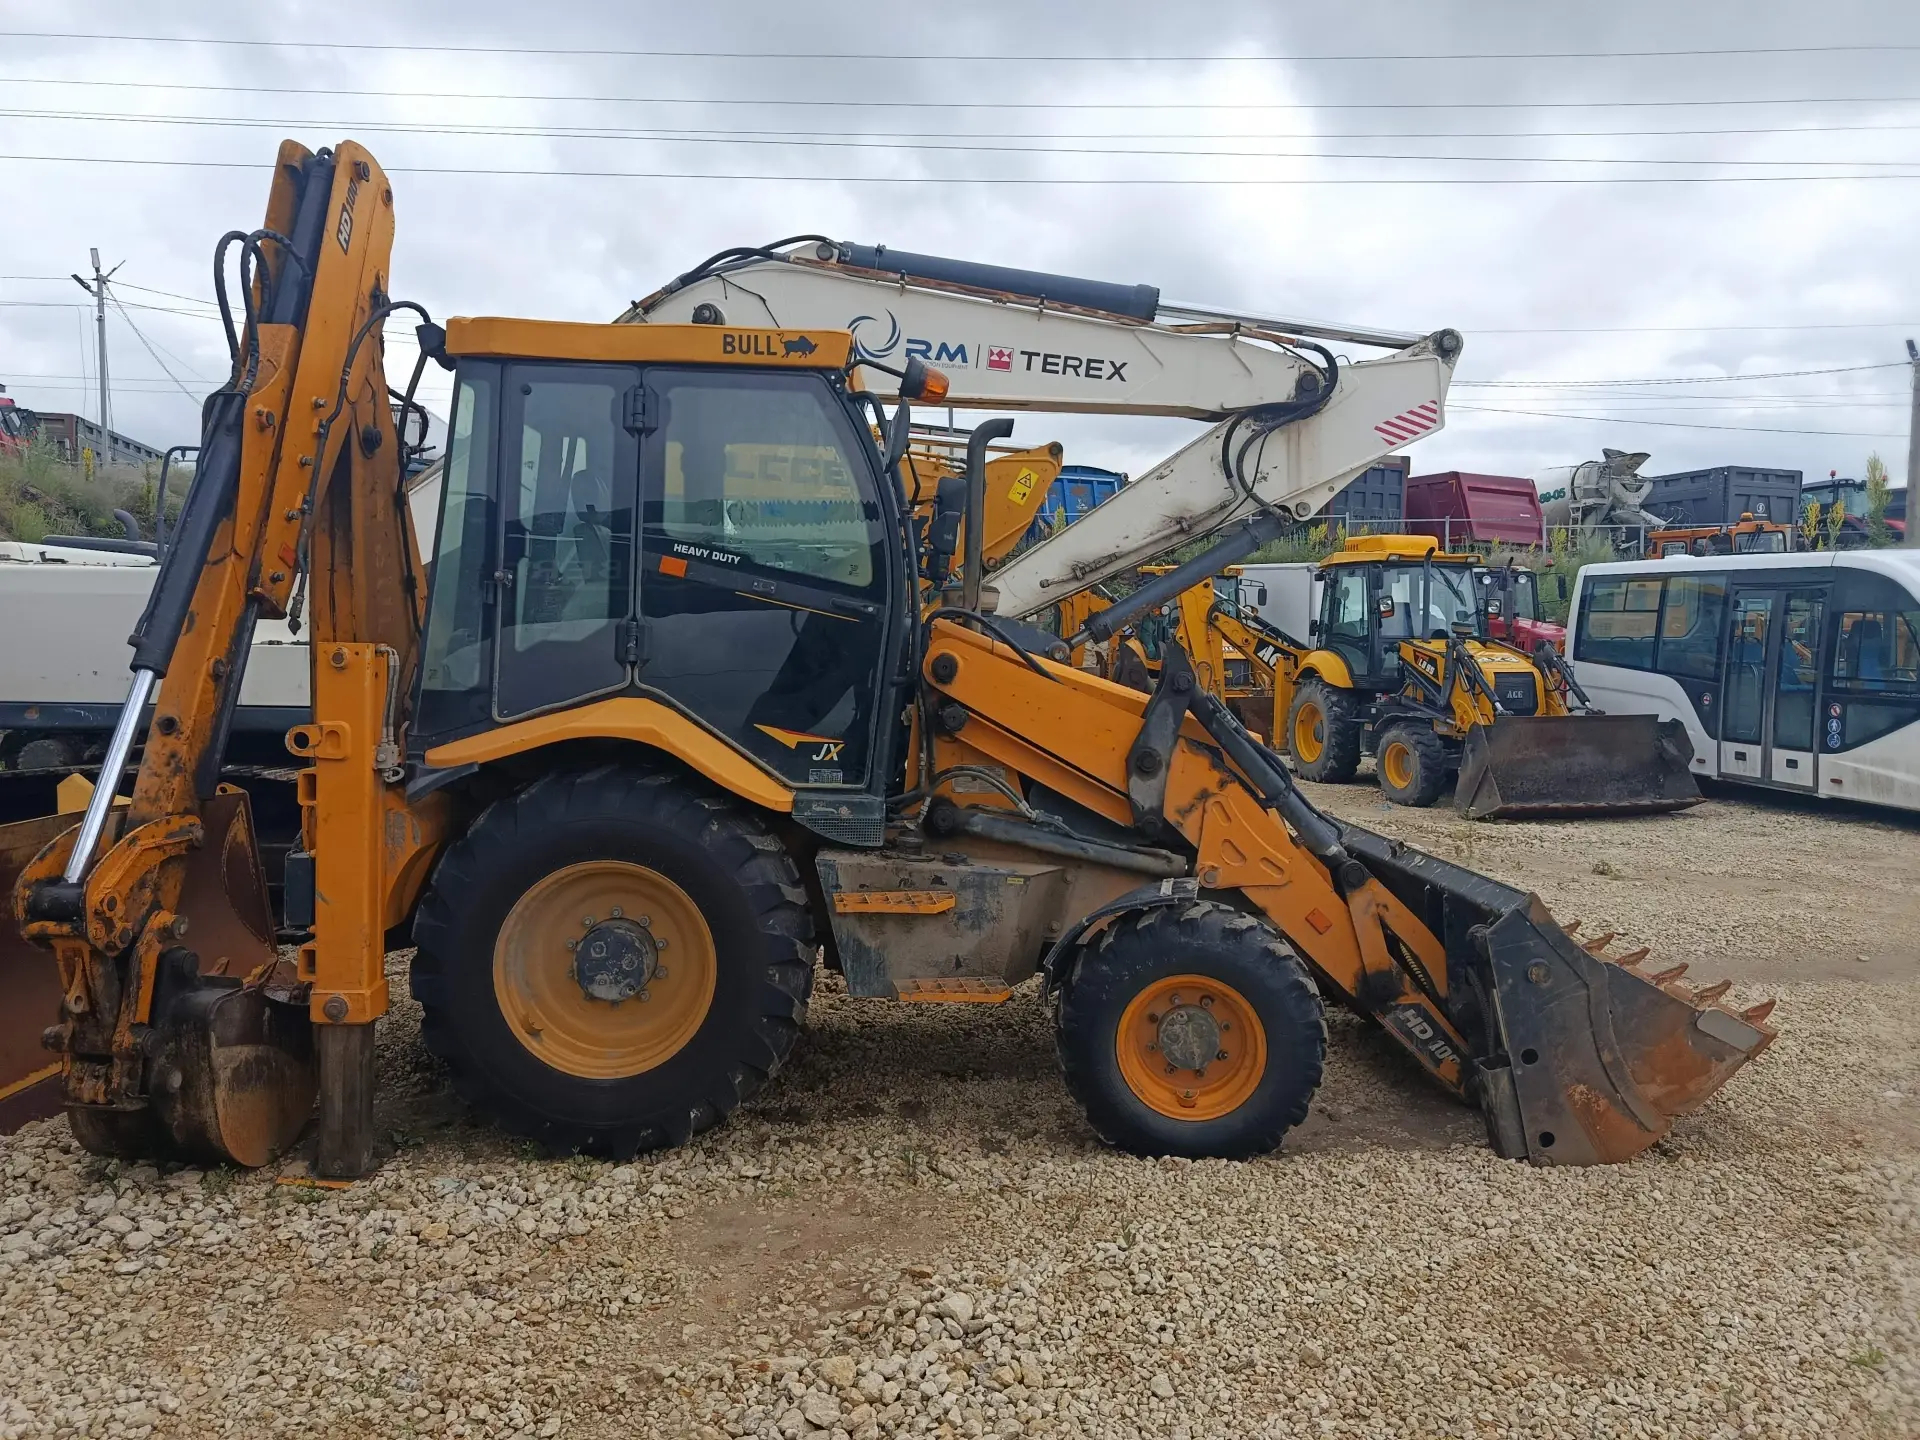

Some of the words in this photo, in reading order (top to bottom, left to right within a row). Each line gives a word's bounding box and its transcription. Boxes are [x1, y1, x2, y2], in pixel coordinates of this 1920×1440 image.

[338, 210, 352, 252] HD
[346, 177, 358, 213] 100
[723, 333, 778, 356] BULL
[1020, 350, 1128, 382] TEREX
[673, 543, 710, 558] HEAVY
[711, 551, 741, 565] DUTY
[1506, 690, 1524, 699] ACE
[812, 743, 846, 761] JX
[1400, 1008, 1434, 1040] HD
